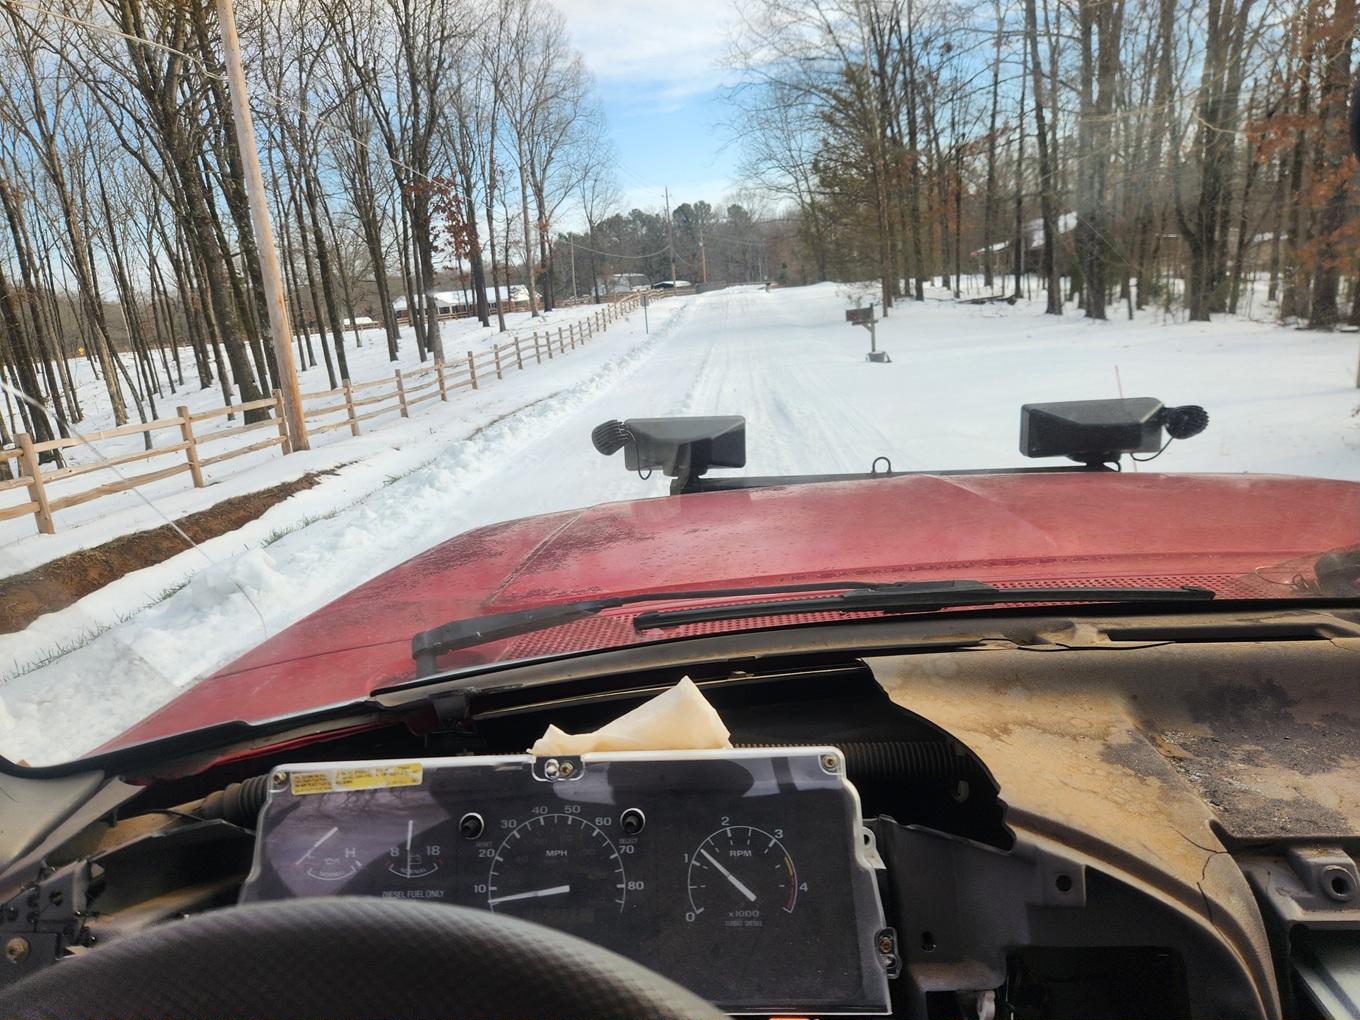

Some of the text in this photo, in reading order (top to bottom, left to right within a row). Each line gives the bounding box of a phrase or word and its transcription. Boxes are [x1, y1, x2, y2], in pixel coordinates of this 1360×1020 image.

[532, 806, 548, 814] 40
[564, 804, 581, 814] 50
[501, 819, 517, 829] 30
[595, 817, 612, 826] 60
[721, 816, 730, 826] 2
[774, 829, 784, 838] 3
[345, 848, 356, 858] H
[390, 846, 400, 857] 8
[426, 846, 440, 856] 18
[478, 849, 495, 858] 20
[619, 846, 634, 854] 70
[474, 884, 486, 894] 10
[627, 881, 645, 890] 80
[800, 882, 808, 892] 4
[407, 890, 424, 898] FUEL
[424, 890, 445, 898] ONLY
[686, 912, 696, 922] 0
